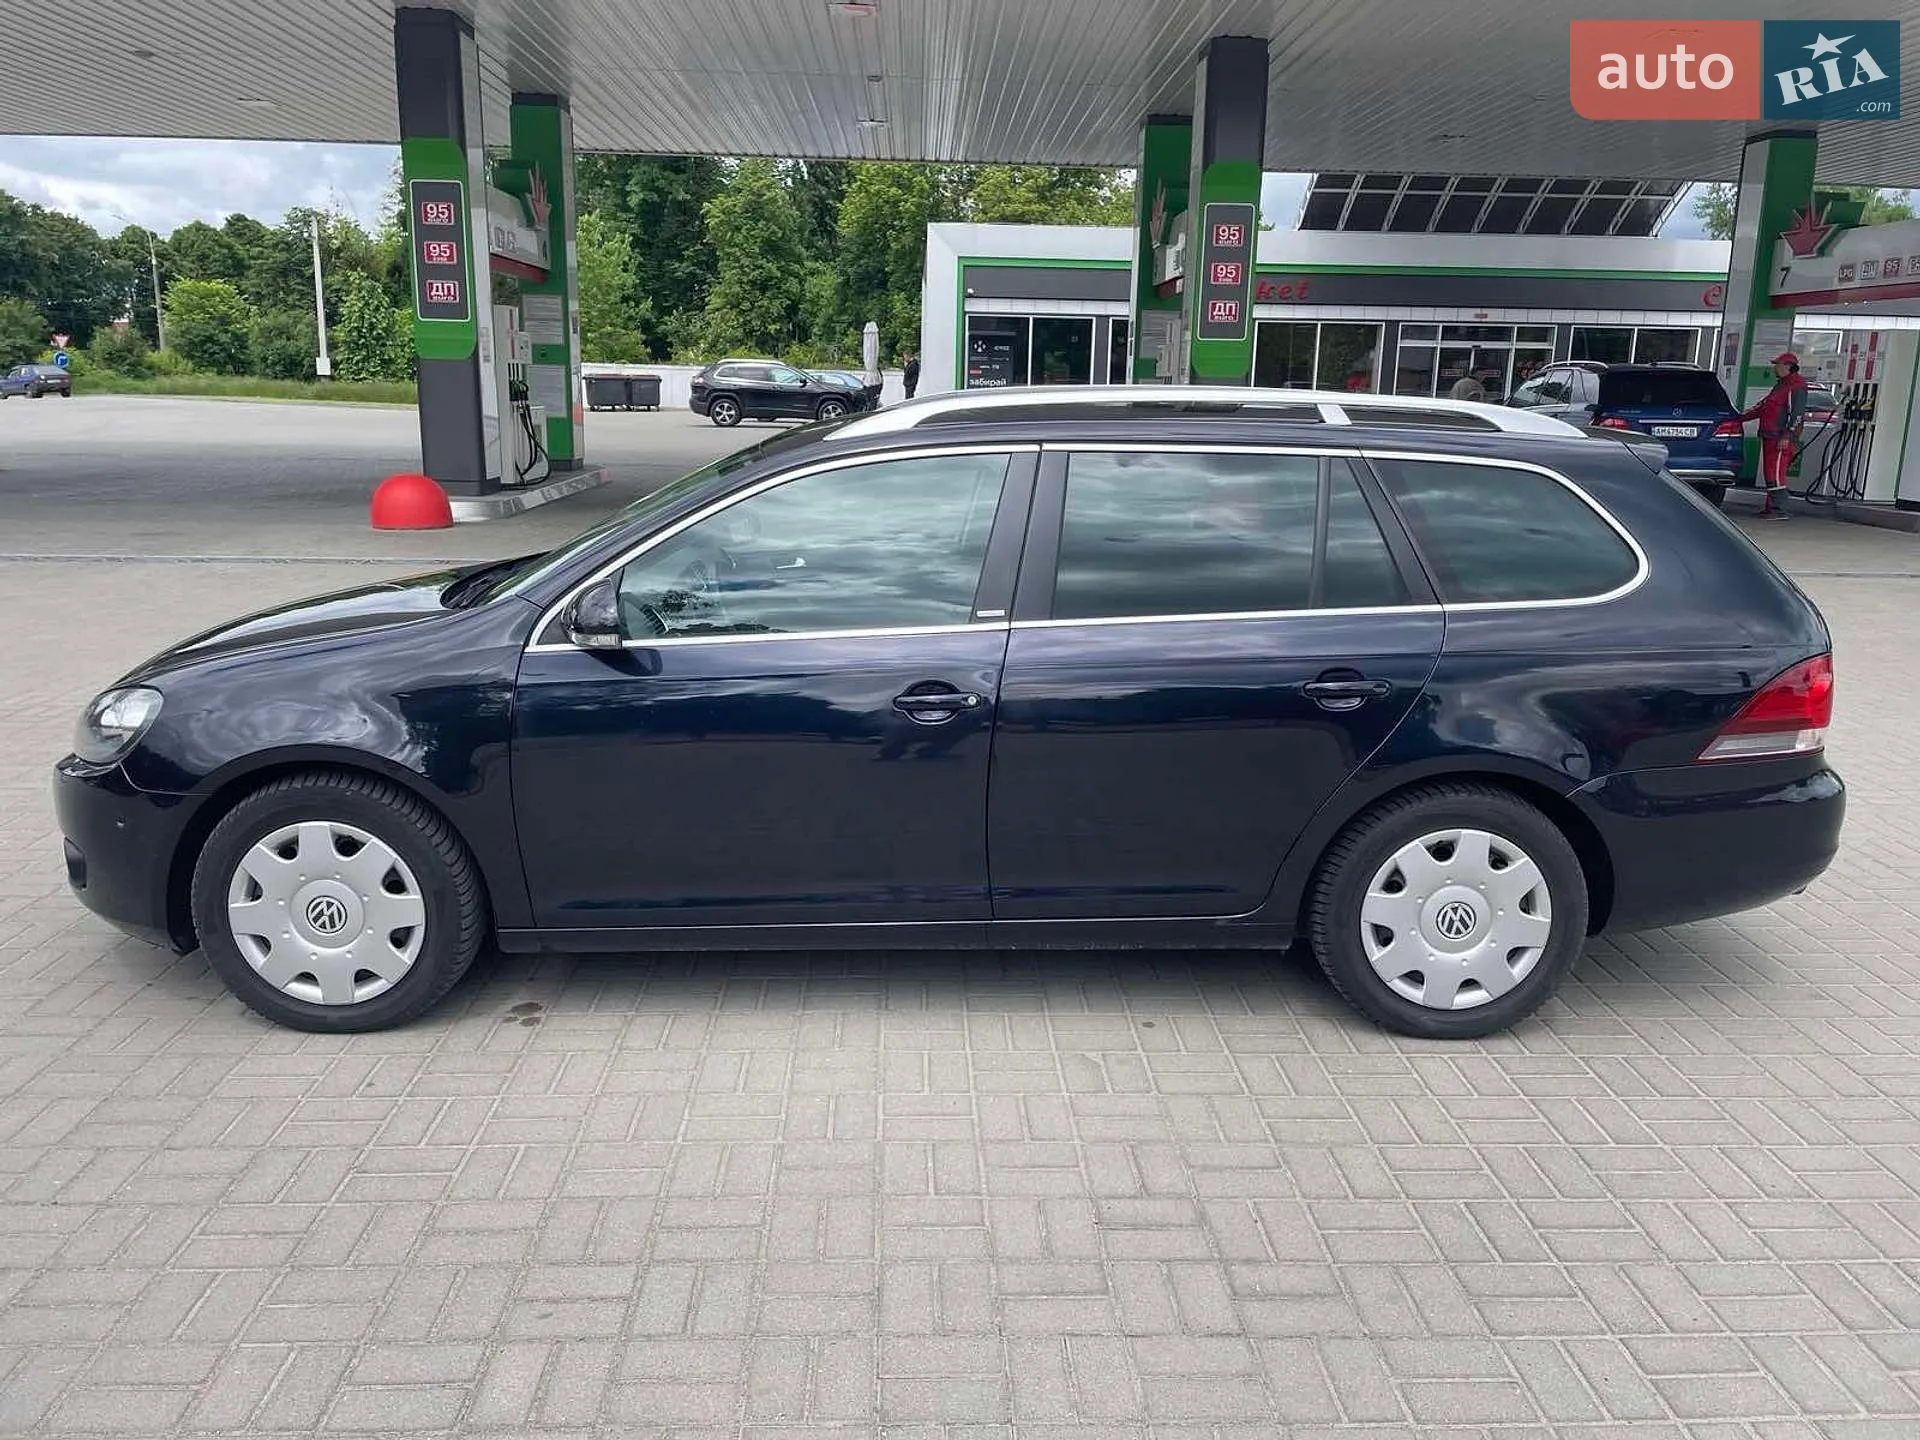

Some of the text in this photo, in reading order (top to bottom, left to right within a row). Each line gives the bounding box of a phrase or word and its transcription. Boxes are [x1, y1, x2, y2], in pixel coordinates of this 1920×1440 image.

[426, 203, 449, 219] 95
[1218, 226, 1240, 241] 95
[429, 243, 450, 257] 95
[1216, 265, 1236, 279] 95
[1779, 266, 1792, 289] 7
[430, 283, 455, 297] ДП
[1213, 302, 1236, 317] ДП
